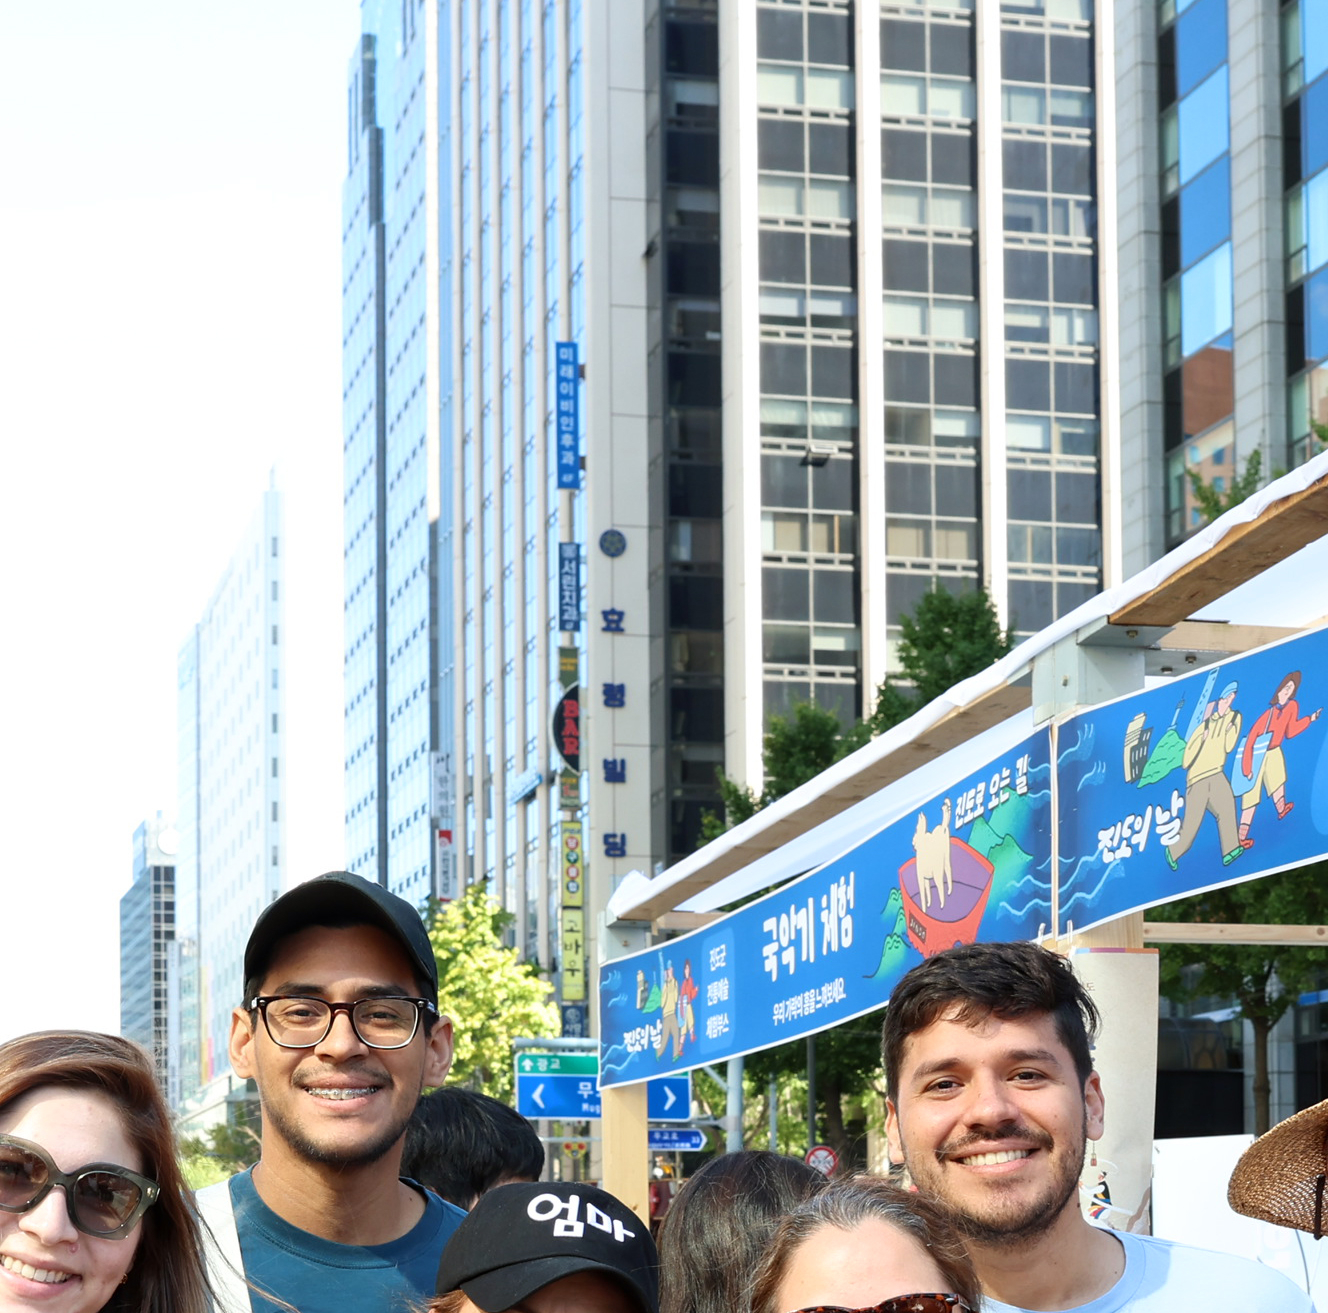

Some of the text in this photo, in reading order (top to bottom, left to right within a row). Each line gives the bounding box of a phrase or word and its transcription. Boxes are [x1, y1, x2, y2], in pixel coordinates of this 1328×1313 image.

[561, 699, 580, 756] BAR
[955, 754, 1029, 830] 진도로 오는 길
[1096, 788, 1185, 864] 진도의 날
[762, 870, 855, 983] 국악기 체험
[650, 1019, 662, 1049] 날
[536, 1057, 562, 1073] 광교
[577, 1081, 602, 1099] 무
[581, 1102, 602, 1114] Mug
[526, 1192, 637, 1243] 엄마
